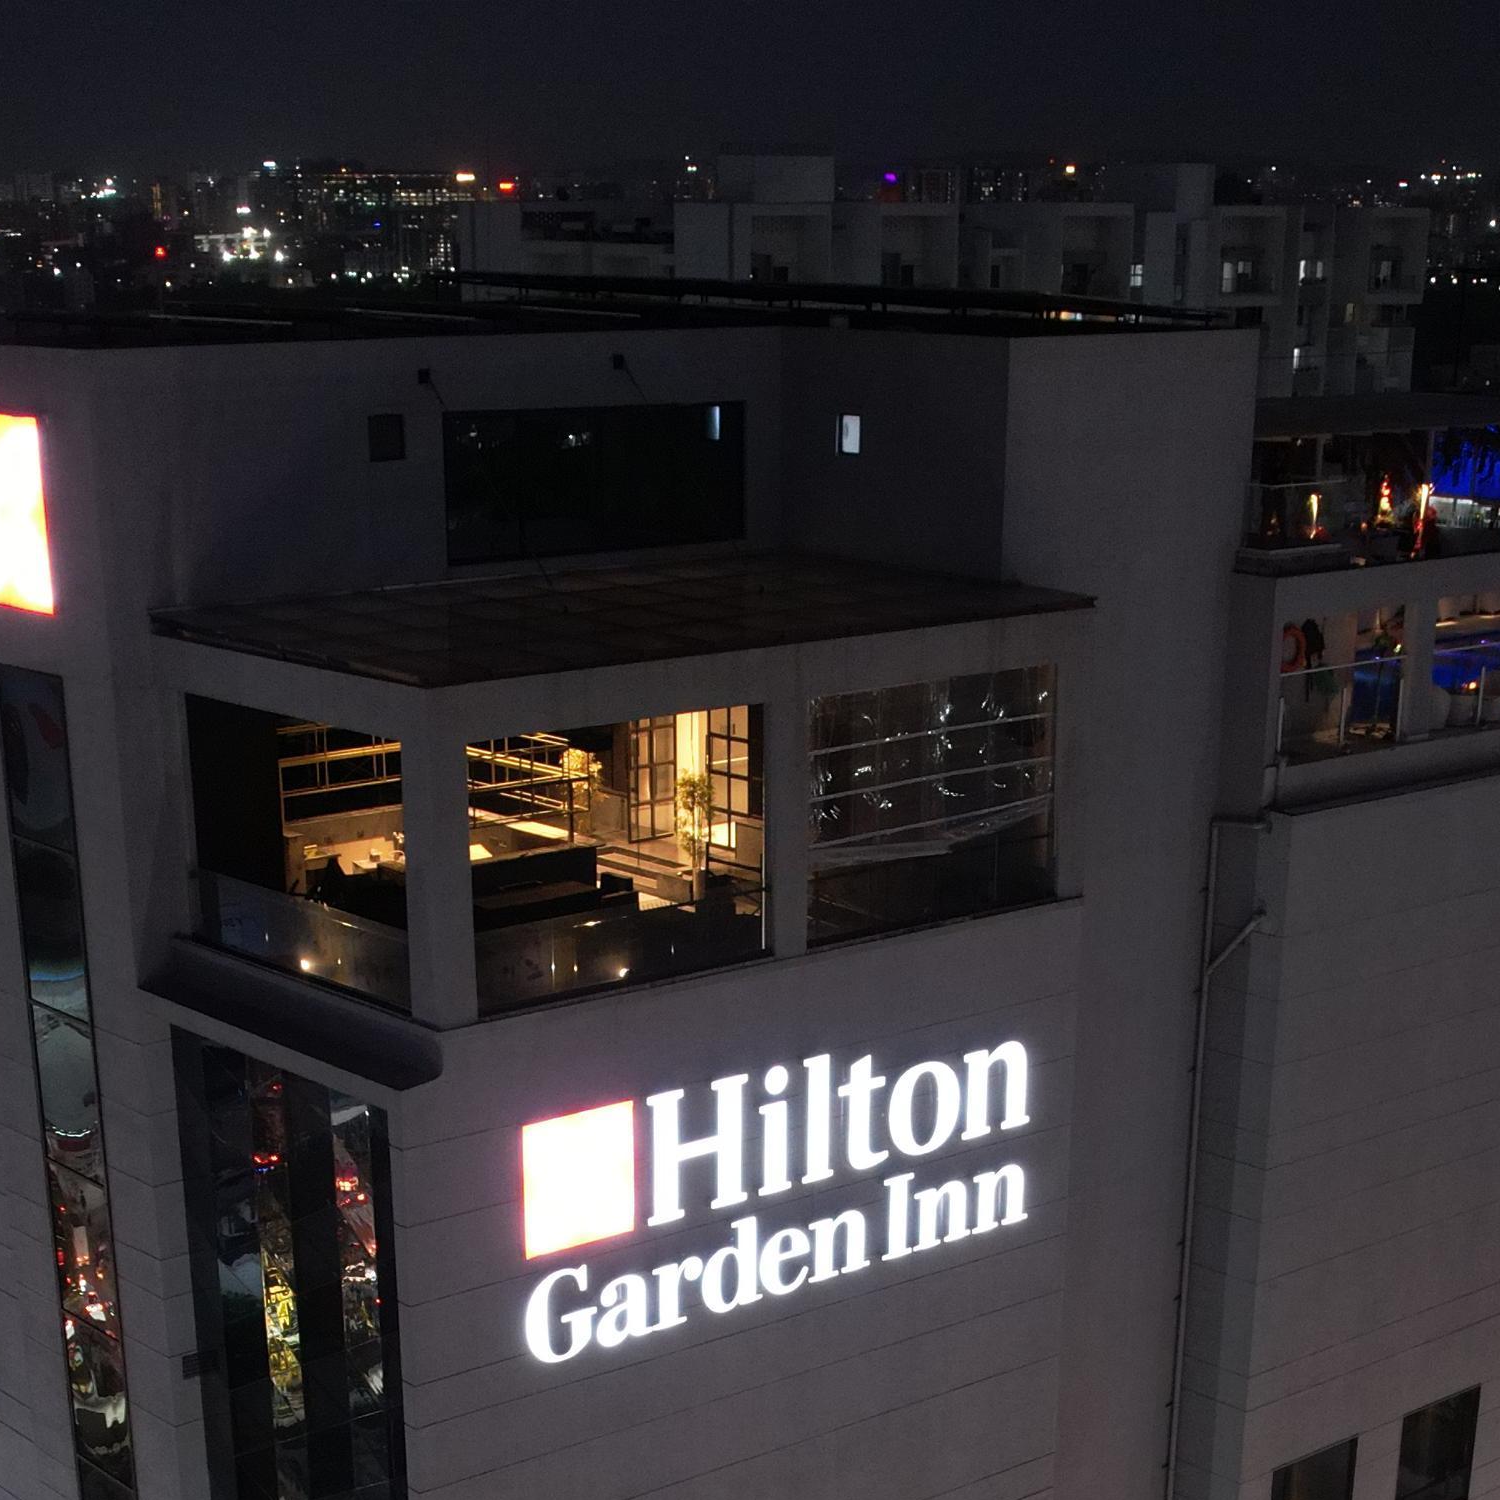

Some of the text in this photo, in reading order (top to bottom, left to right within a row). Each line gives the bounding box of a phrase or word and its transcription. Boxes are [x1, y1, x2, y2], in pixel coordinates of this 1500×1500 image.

[645, 1039, 1030, 1229] Hilton
[523, 1162, 1030, 1365] Garden Inn
